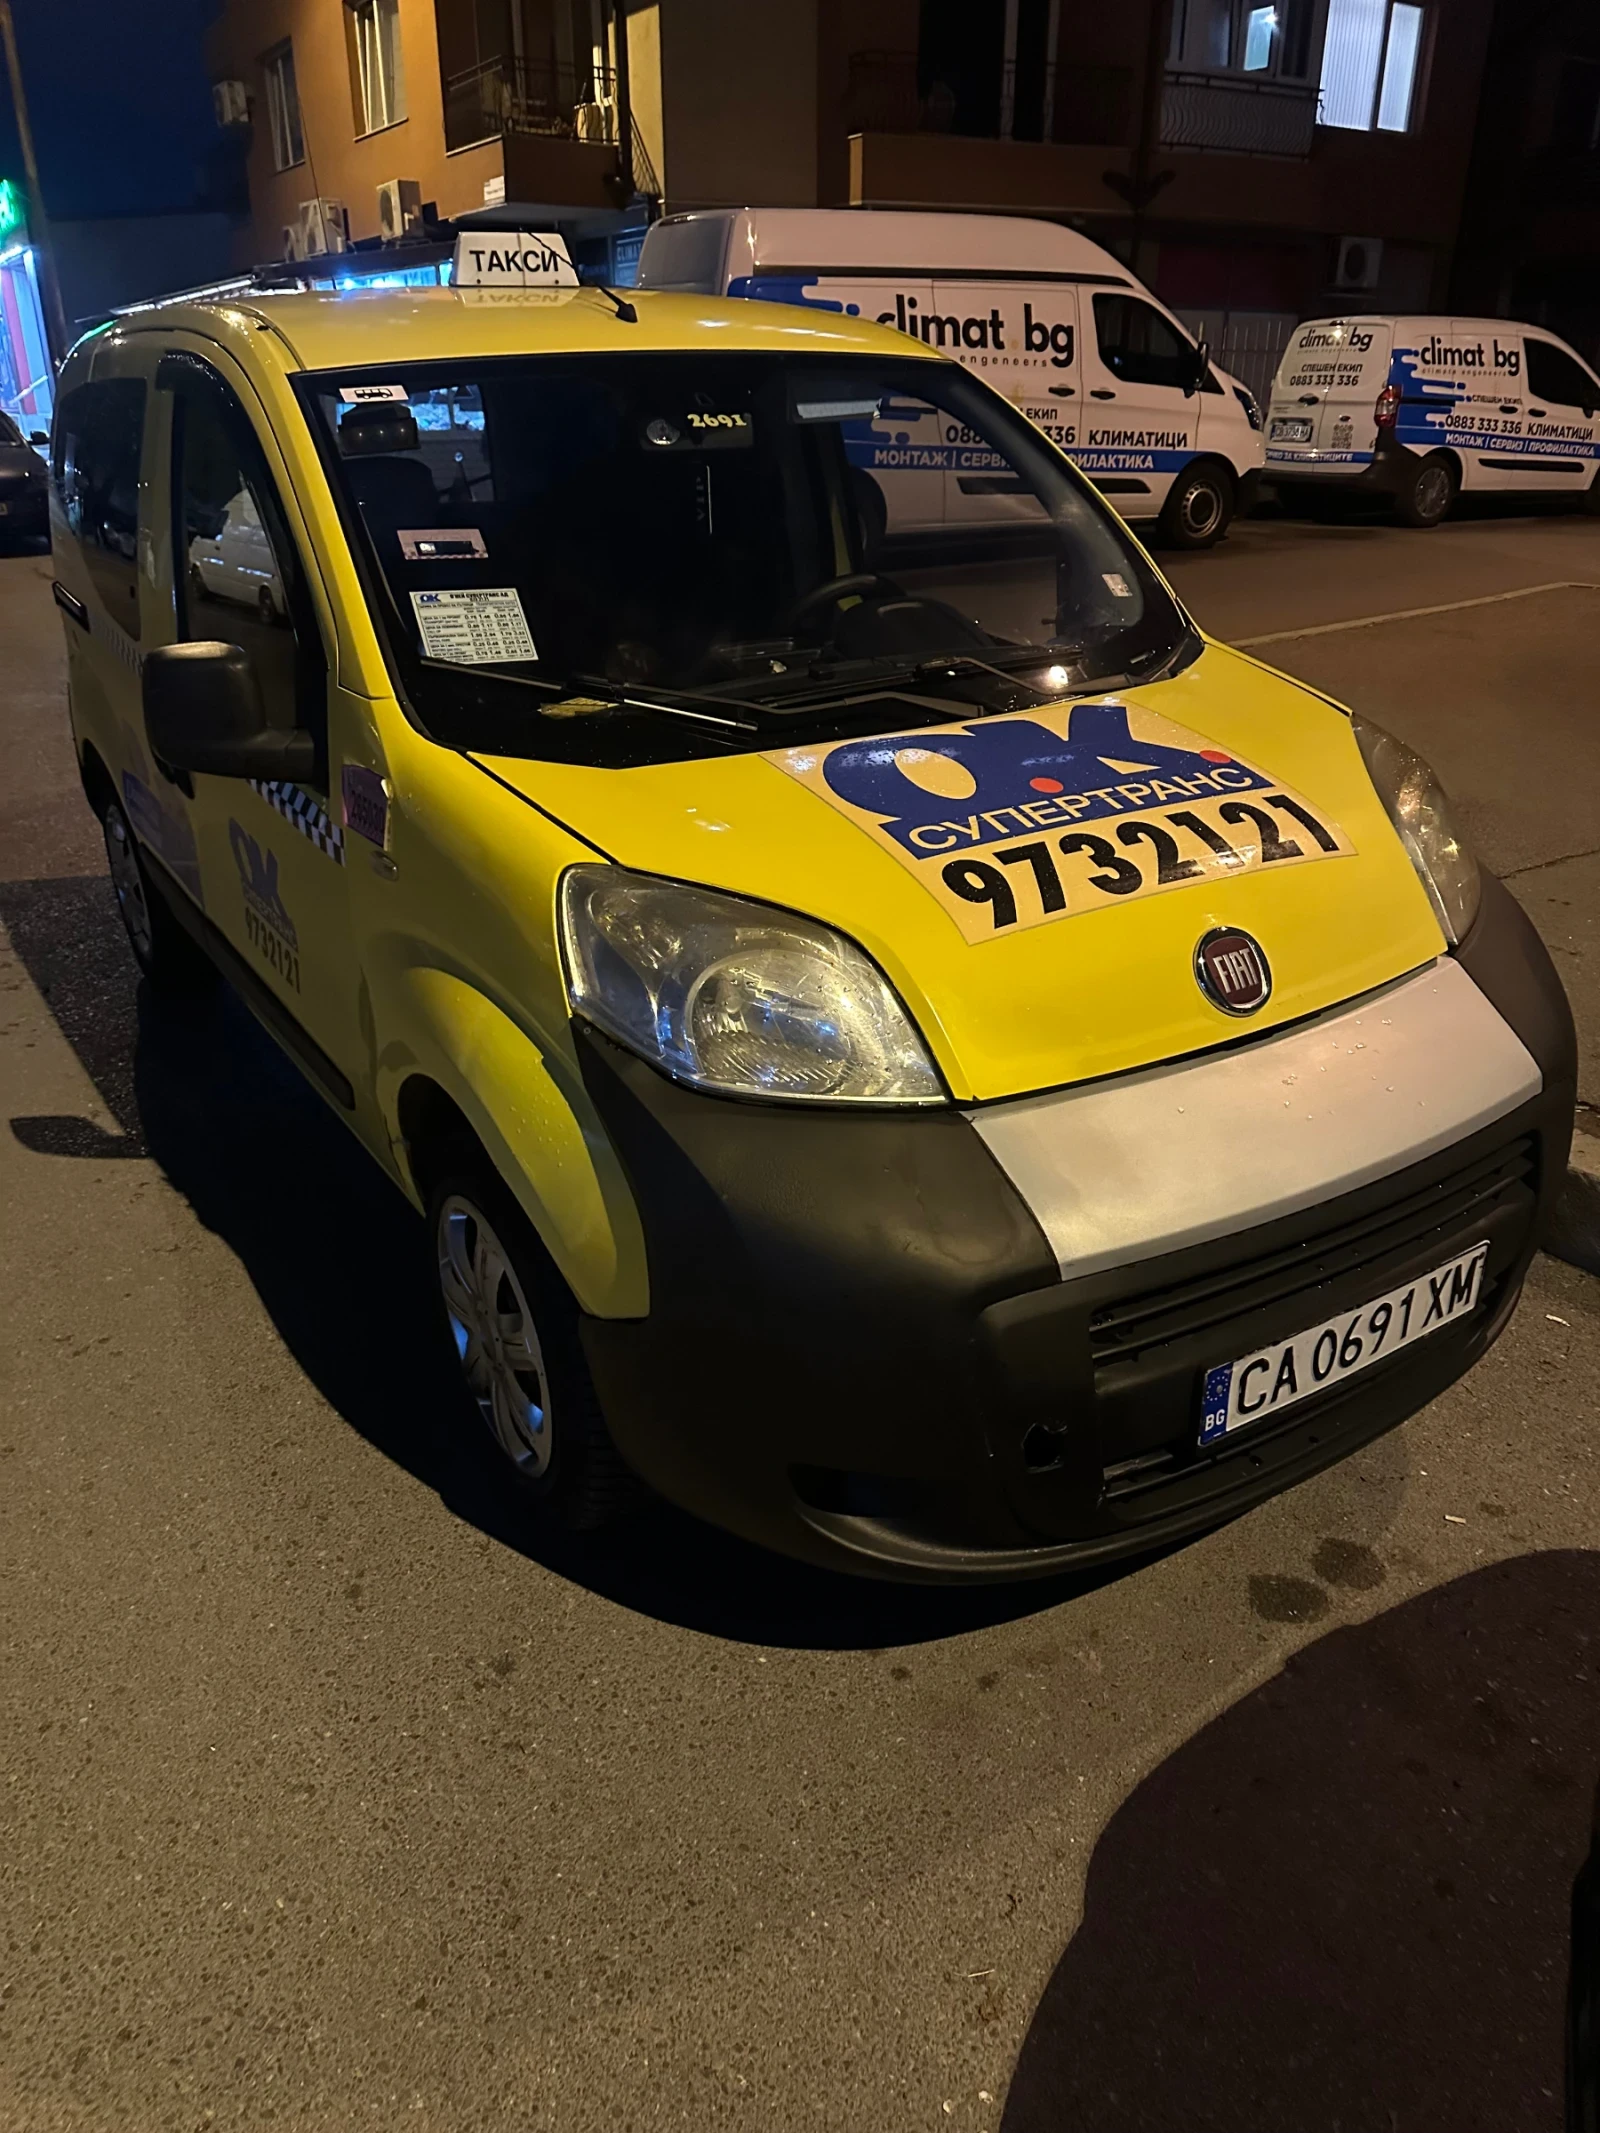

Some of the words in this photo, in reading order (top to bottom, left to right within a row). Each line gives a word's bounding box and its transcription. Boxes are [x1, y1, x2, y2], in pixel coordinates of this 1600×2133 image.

[469, 250, 559, 272] ТАКСИ
[960, 354, 1047, 368] engeneers
[1301, 364, 1335, 373] СПЕШЕН
[1337, 364, 1363, 373] ЕКИП
[1290, 375, 1314, 386] 0883
[1315, 375, 1334, 386] 333
[1337, 375, 1359, 386] 336
[687, 412, 747, 429] 2691
[1026, 408, 1058, 420] ЕКИП
[1445, 415, 1475, 430] 0883
[1477, 417, 1498, 432] 333
[1501, 419, 1522, 434] 336
[1527, 423, 1593, 441] КЛИМАТИЦИ
[1089, 429, 1187, 450] КЛИМАТИЦИ
[1445, 434, 1483, 447] МОНТАЖ
[1490, 438, 1523, 451] СЕРВИЗ
[1530, 443, 1595, 457] ПРОФИЛАКТИКА
[875, 448, 947, 466] МОНТАЖ
[909, 767, 1252, 850] СУПЕРТРАНС
[942, 795, 1339, 930] 9732121
[1213, 947, 1257, 994] FIAT
[1238, 1345, 1298, 1415] CA
[1312, 1288, 1415, 1382] 0691
[1422, 1256, 1480, 1329] XM
[1205, 1409, 1225, 1432] BG
